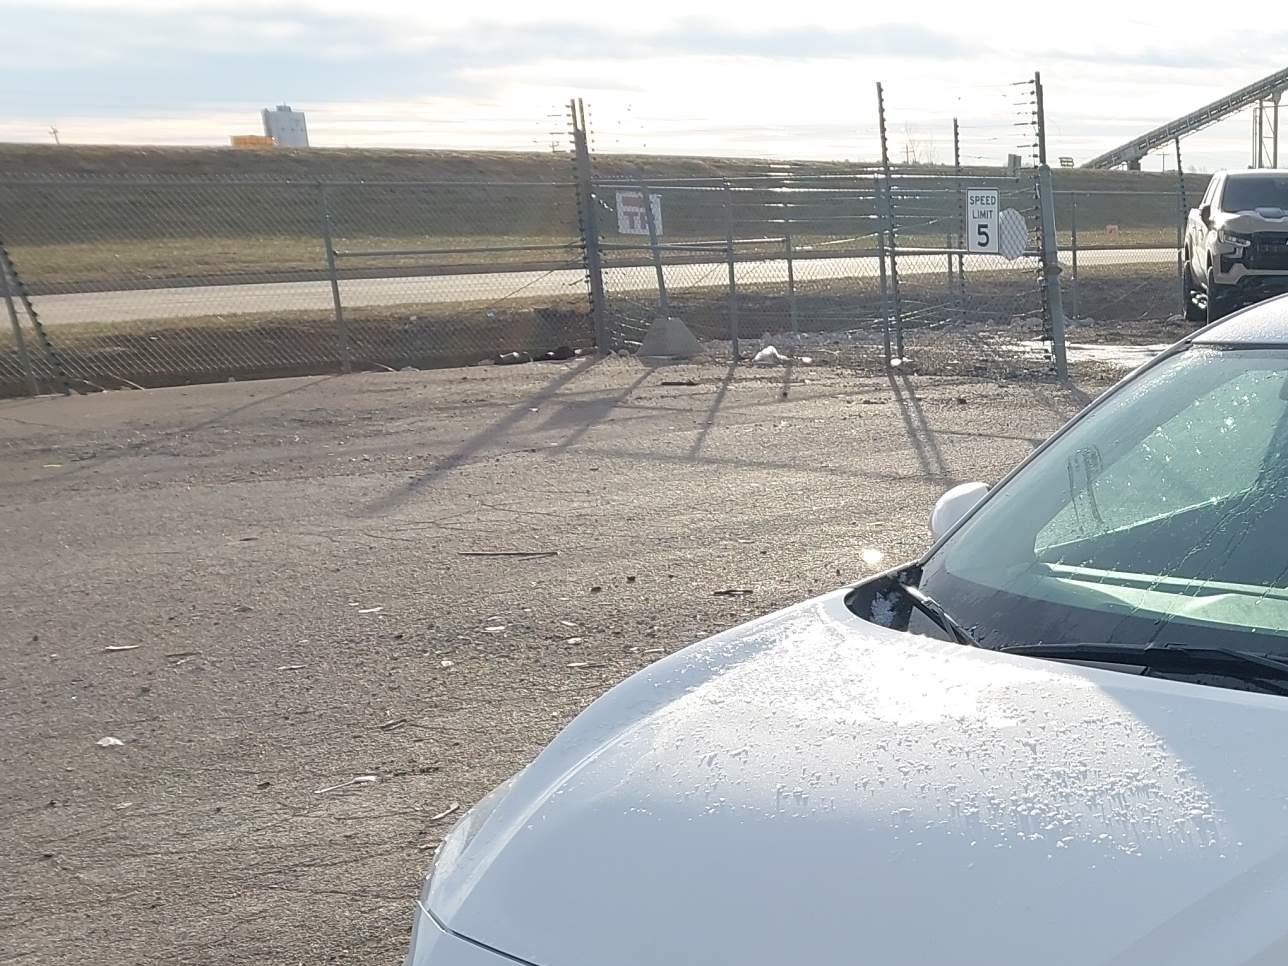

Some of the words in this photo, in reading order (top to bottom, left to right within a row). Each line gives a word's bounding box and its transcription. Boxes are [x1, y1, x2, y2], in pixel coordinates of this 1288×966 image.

[969, 195, 996, 206] SPEED
[972, 209, 993, 219] LIMIT
[977, 223, 990, 247] 5
